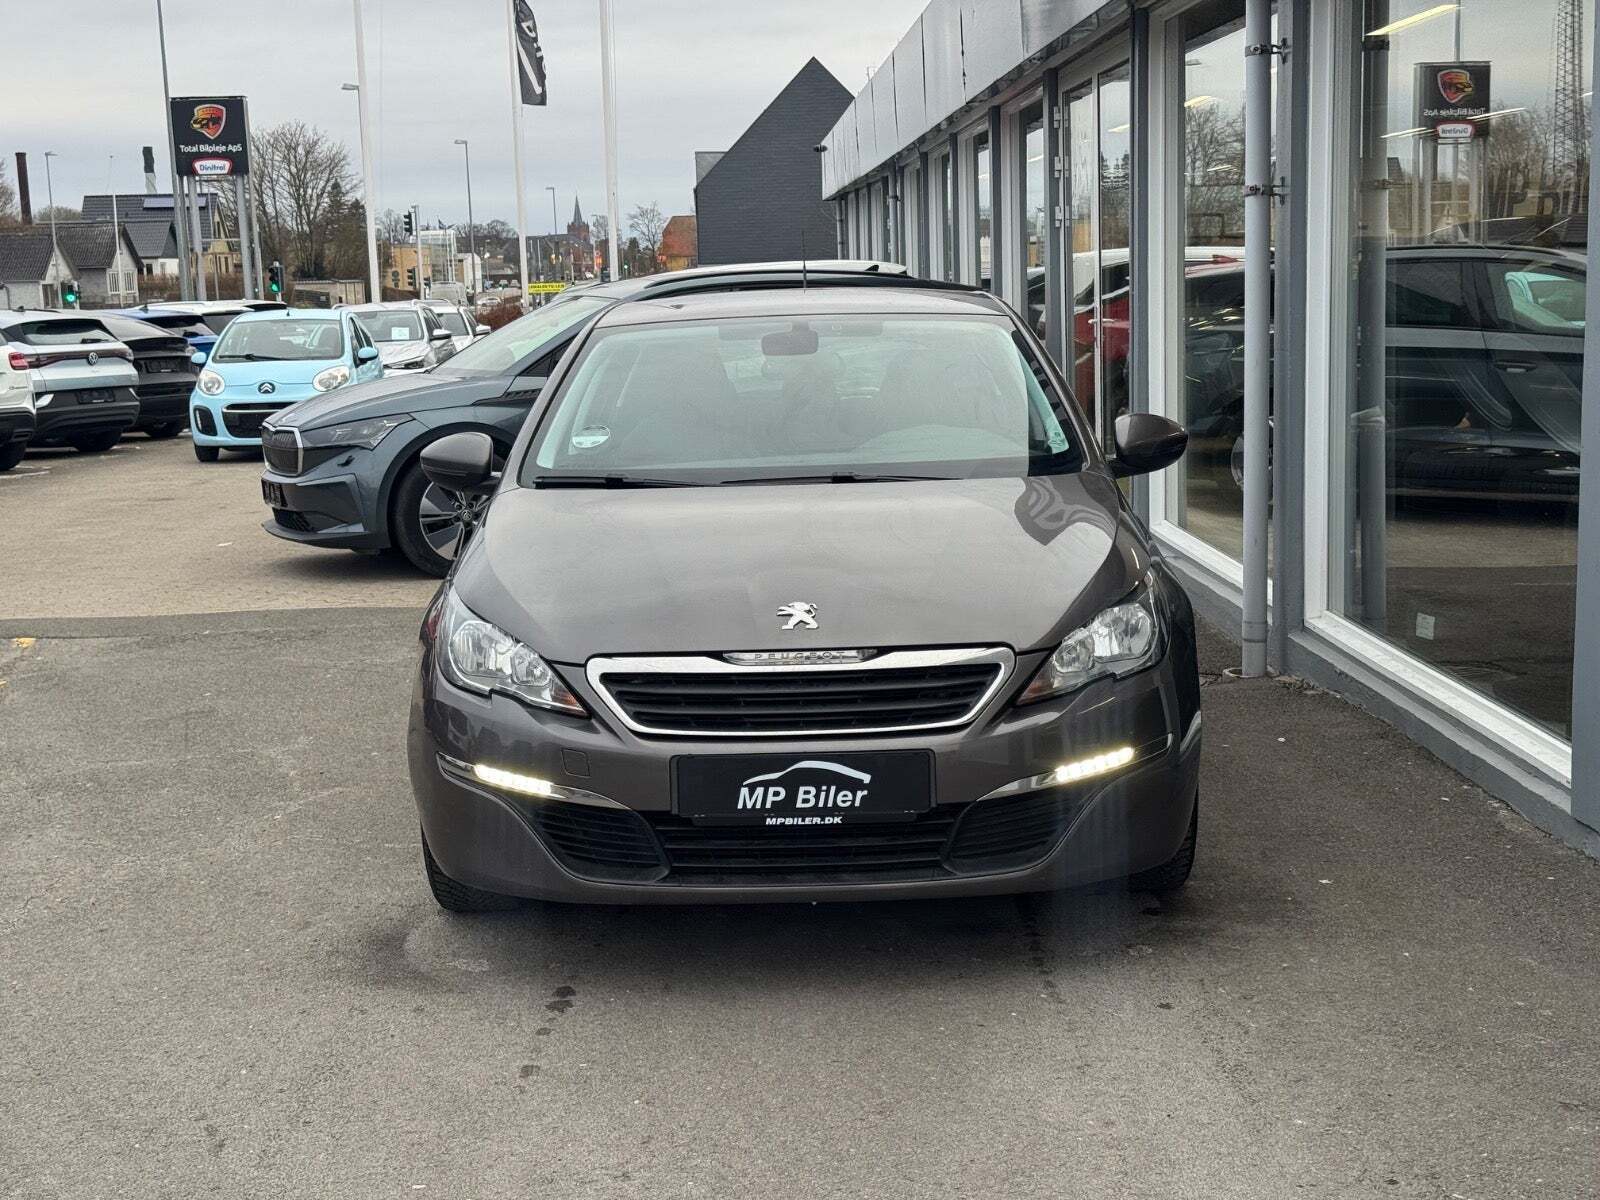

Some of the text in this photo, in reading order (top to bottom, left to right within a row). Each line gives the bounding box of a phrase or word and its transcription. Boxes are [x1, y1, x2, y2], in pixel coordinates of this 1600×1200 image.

[179, 143, 242, 154] Total Bilpleje ApS
[199, 164, 226, 172] Dinitrol
[754, 651, 845, 661] PEUGEOT
[737, 785, 868, 809] MP Biler
[765, 815, 843, 825] MPBILER.DK
